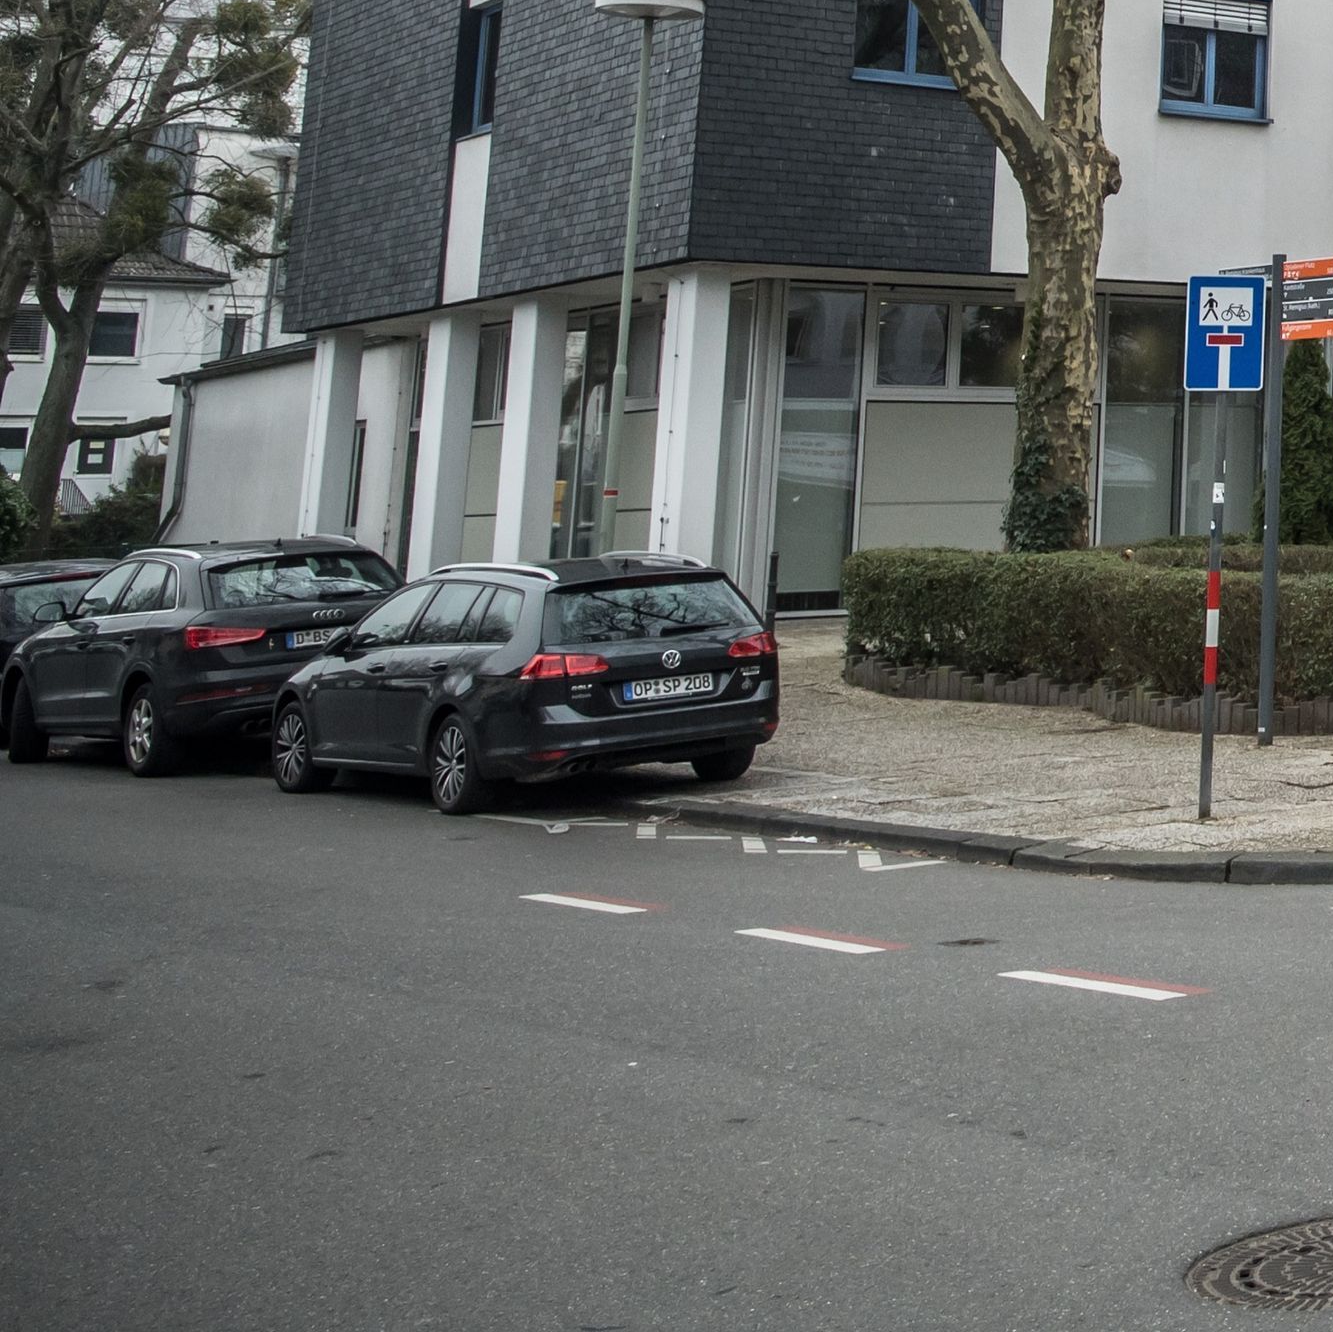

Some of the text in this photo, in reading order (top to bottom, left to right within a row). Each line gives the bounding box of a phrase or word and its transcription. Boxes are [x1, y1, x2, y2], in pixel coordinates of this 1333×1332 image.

[296, 633, 304, 645] D
[634, 674, 711, 696] OP SP 208
